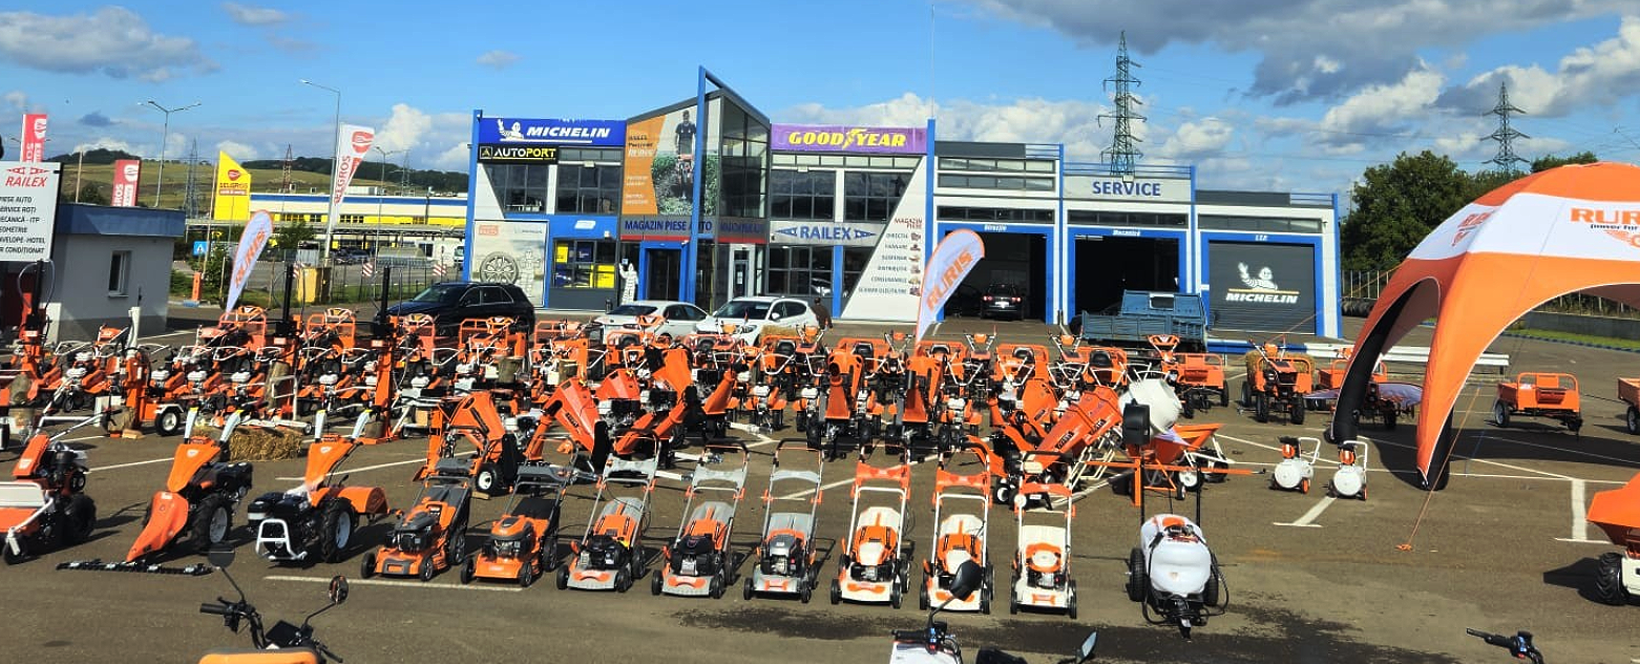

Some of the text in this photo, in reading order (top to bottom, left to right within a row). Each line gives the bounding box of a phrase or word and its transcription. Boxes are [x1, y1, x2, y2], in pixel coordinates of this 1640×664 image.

[526, 126, 610, 138] MICHELIN
[493, 147, 556, 159] AUTOPORT
[5, 176, 47, 187] RAILEX
[1092, 181, 1161, 197] SERVICE
[1569, 207, 1640, 225] RUR
[624, 220, 663, 231] MAGAZIN
[664, 220, 687, 231] PIESE
[800, 225, 851, 240] RAILEX
[926, 250, 974, 313] RURIS
[1225, 292, 1298, 304] MICHELIN
